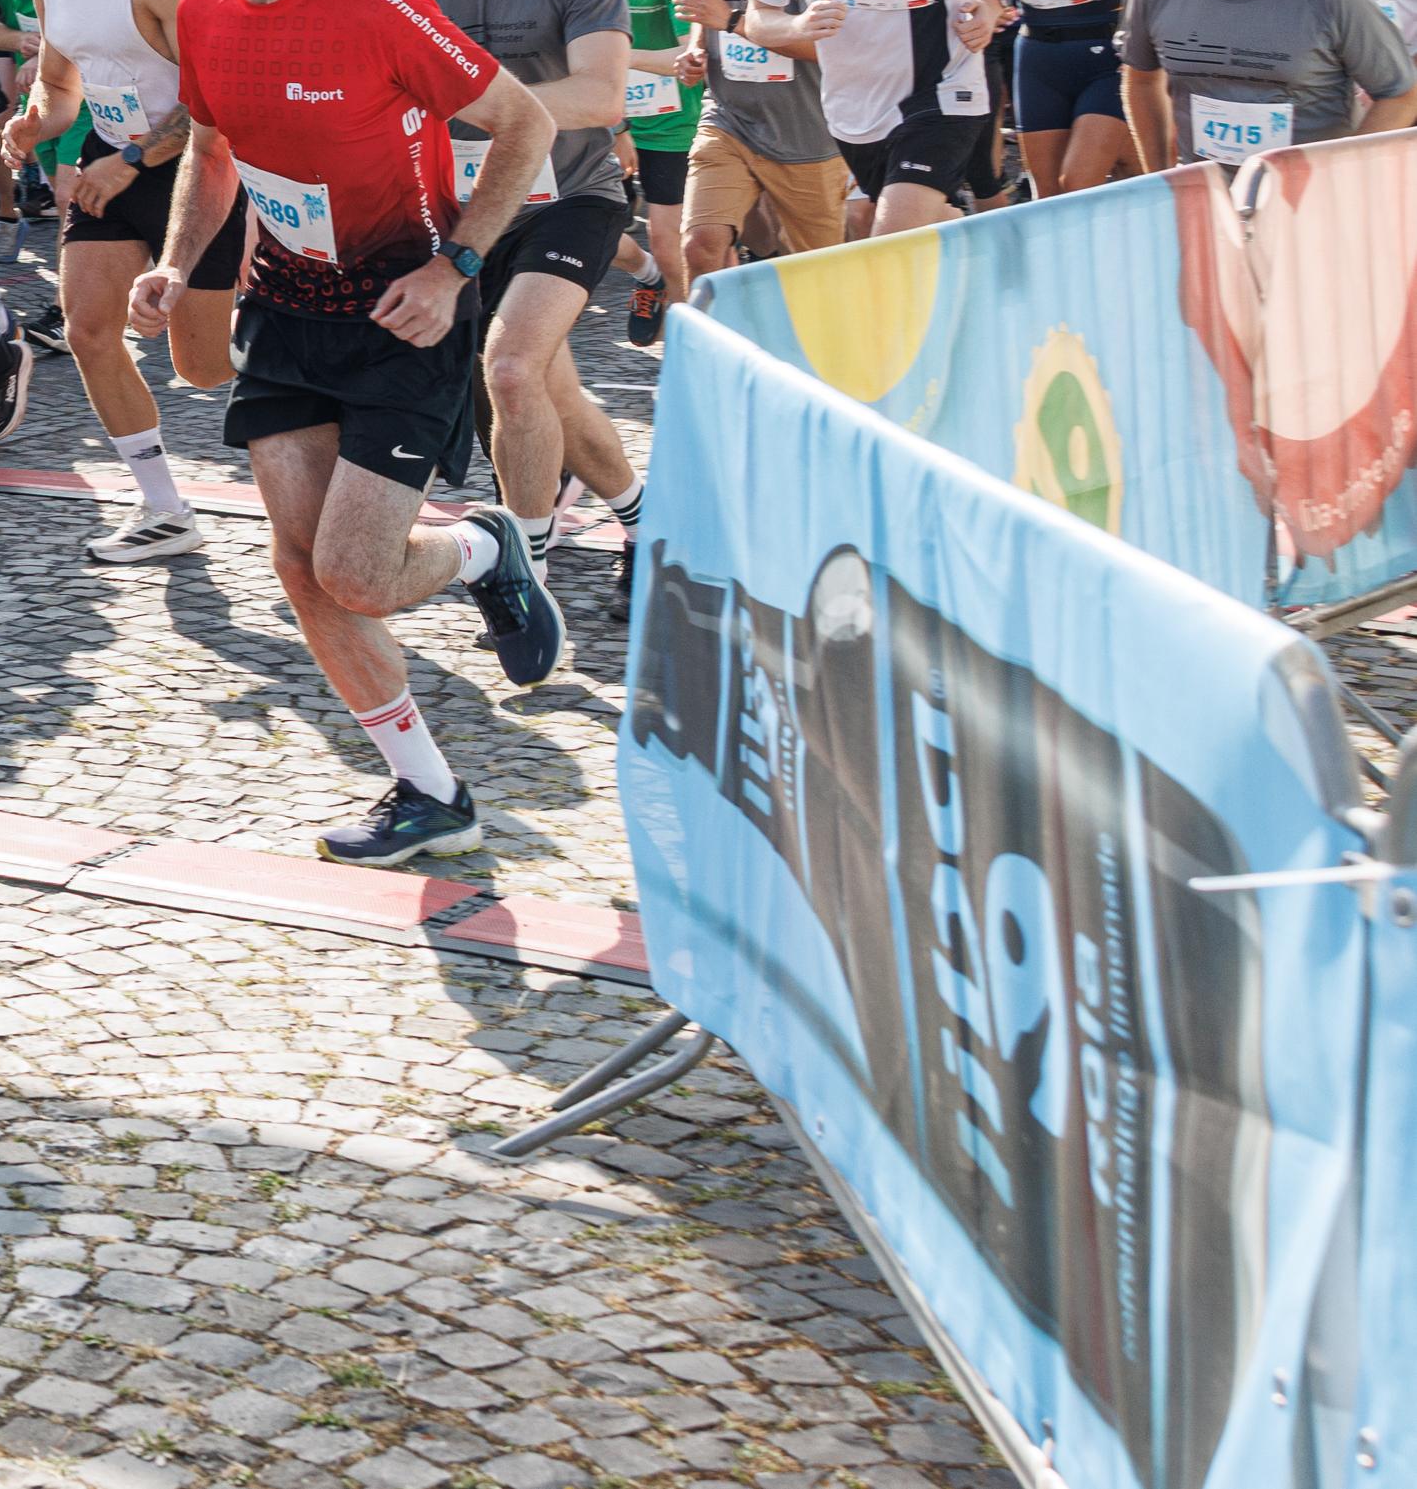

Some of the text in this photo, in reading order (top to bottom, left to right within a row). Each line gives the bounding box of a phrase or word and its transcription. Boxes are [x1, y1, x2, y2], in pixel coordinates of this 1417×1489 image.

[726, 42, 769, 63] 4823
[1203, 119, 1262, 145] 4715
[560, 255, 583, 268] JAKO
